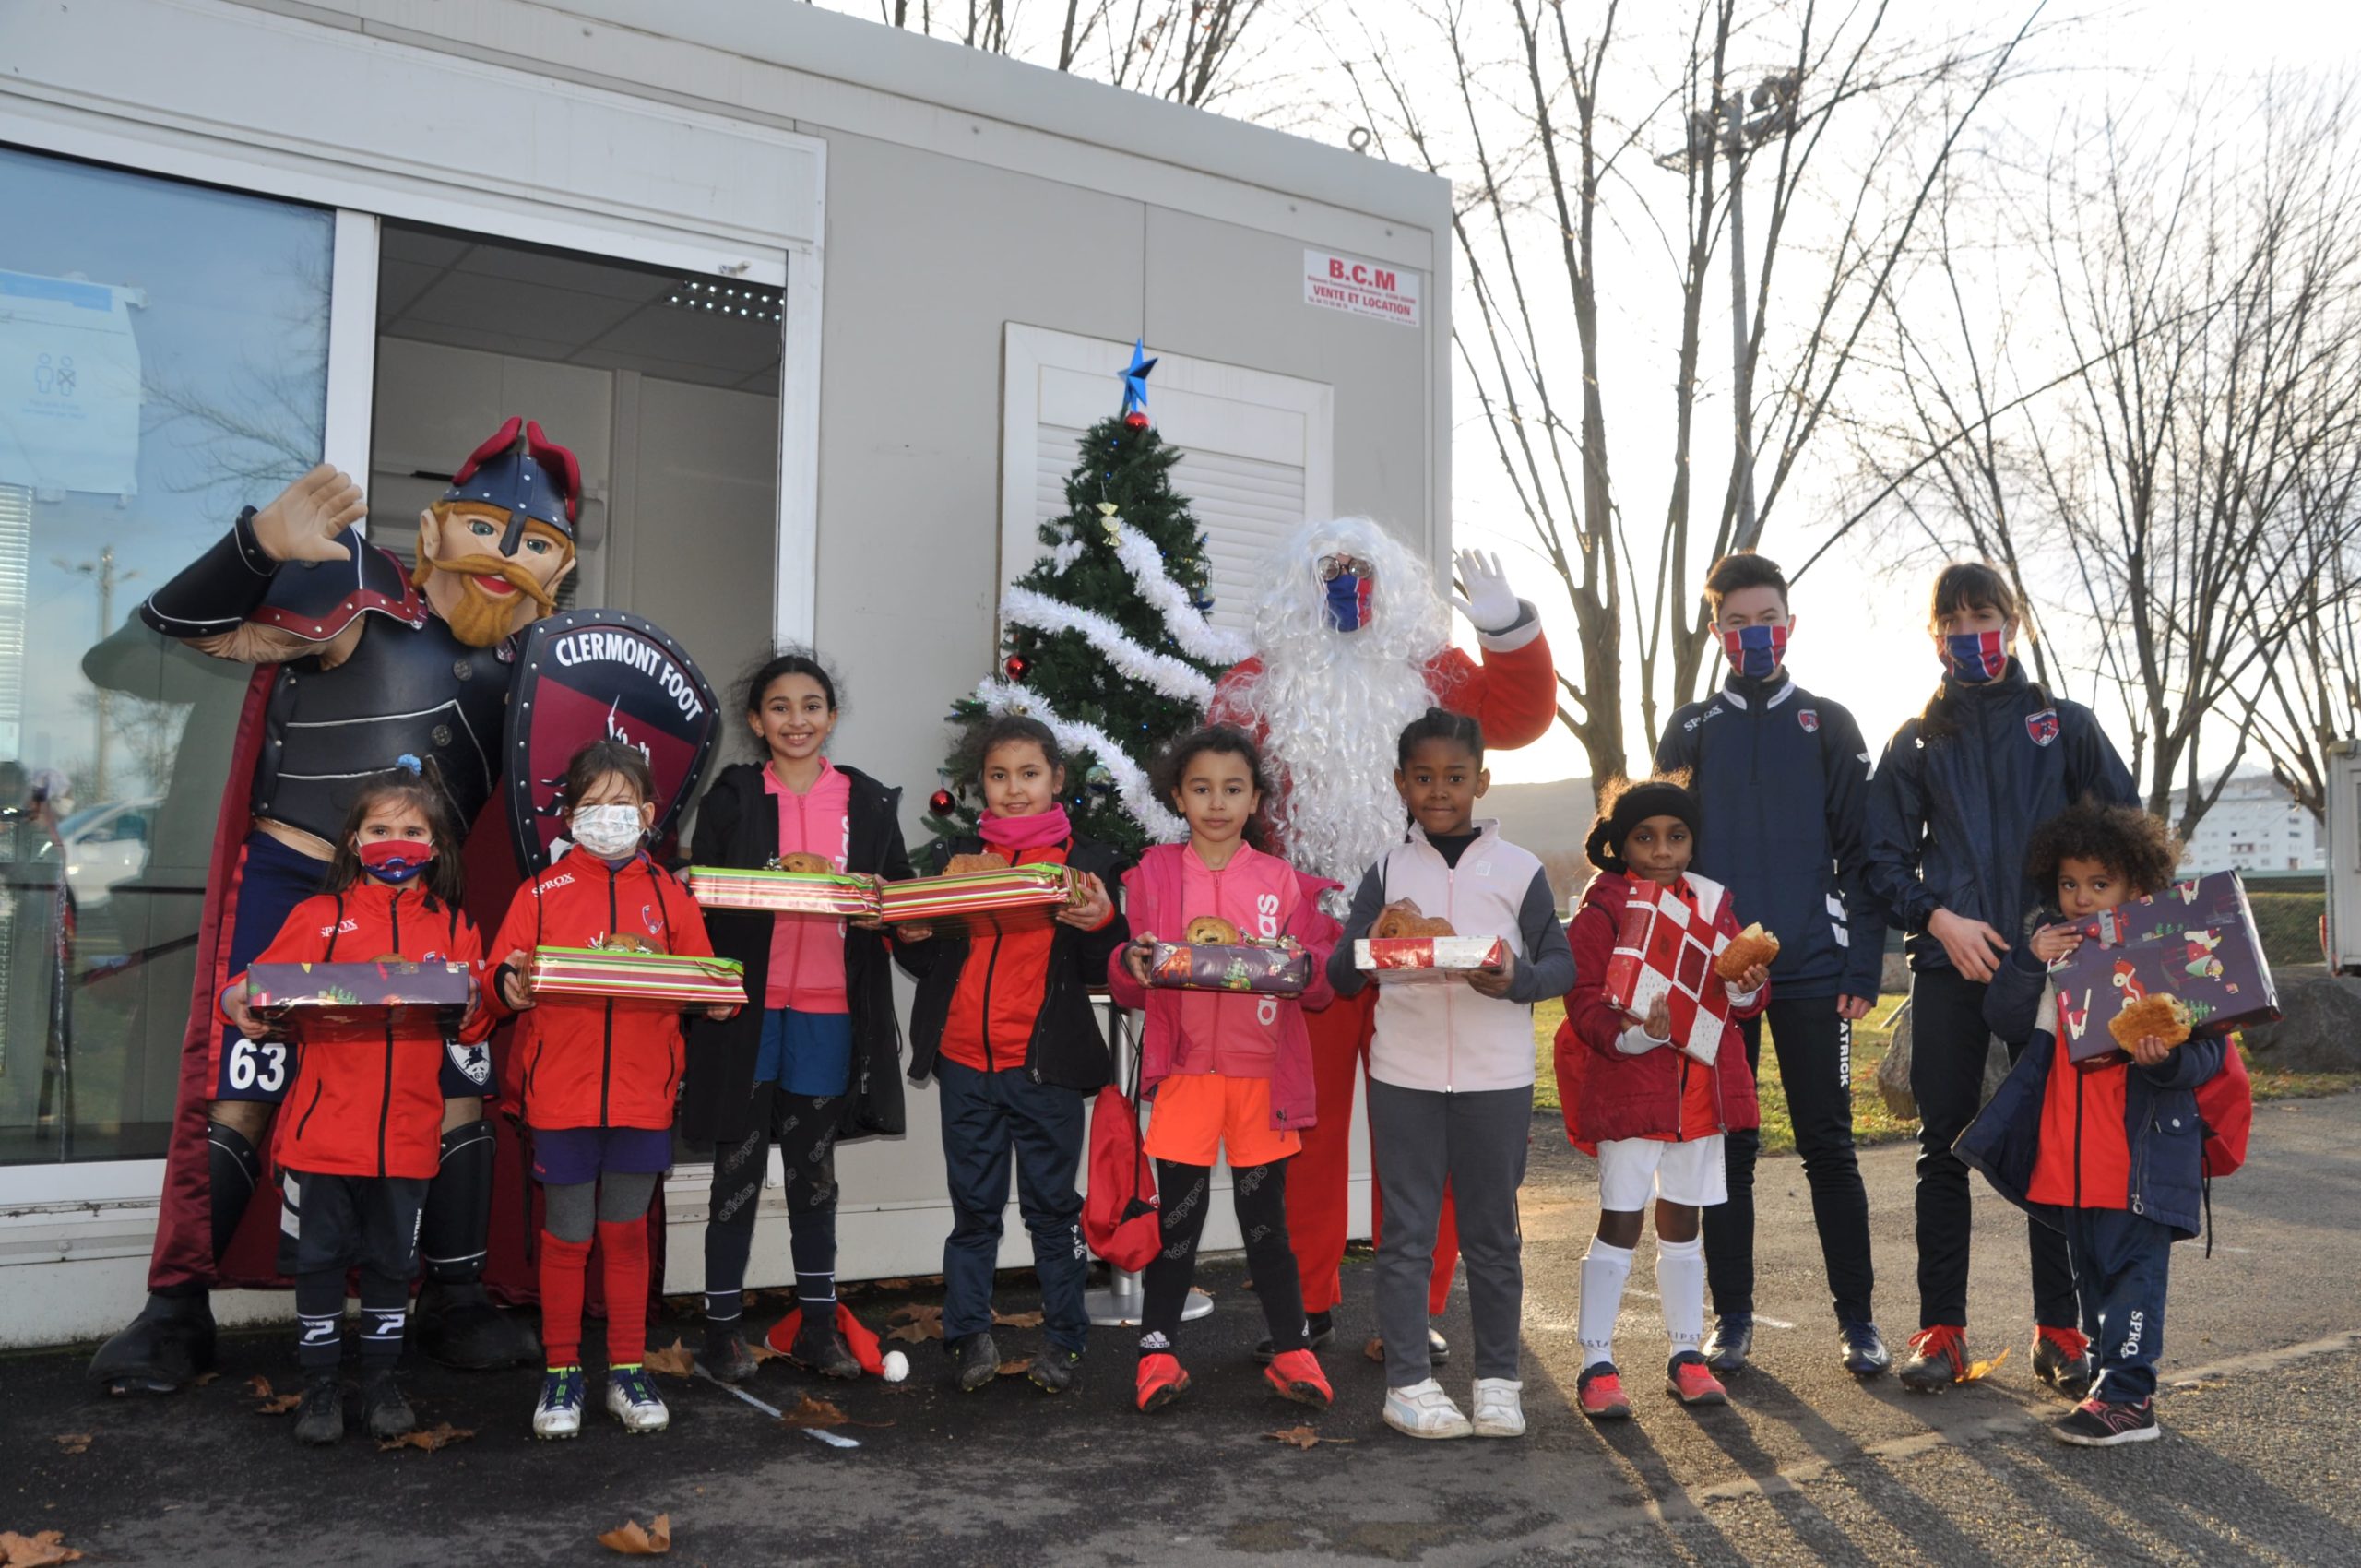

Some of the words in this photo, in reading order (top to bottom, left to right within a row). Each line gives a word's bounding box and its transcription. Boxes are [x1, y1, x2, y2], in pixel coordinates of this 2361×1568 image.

[1329, 257, 1395, 291] B.C.M
[1313, 285, 1345, 301] VENTE
[1348, 293, 1358, 303] ET
[1363, 296, 1410, 315] LOCATION
[555, 633, 661, 677] CLERMONT
[659, 663, 703, 722] FOOT
[229, 1039, 287, 1092] 63
[718, 1182, 757, 1222] adidas
[1164, 1177, 1205, 1229] adidas
[2126, 1311, 2143, 1355] SPRO
